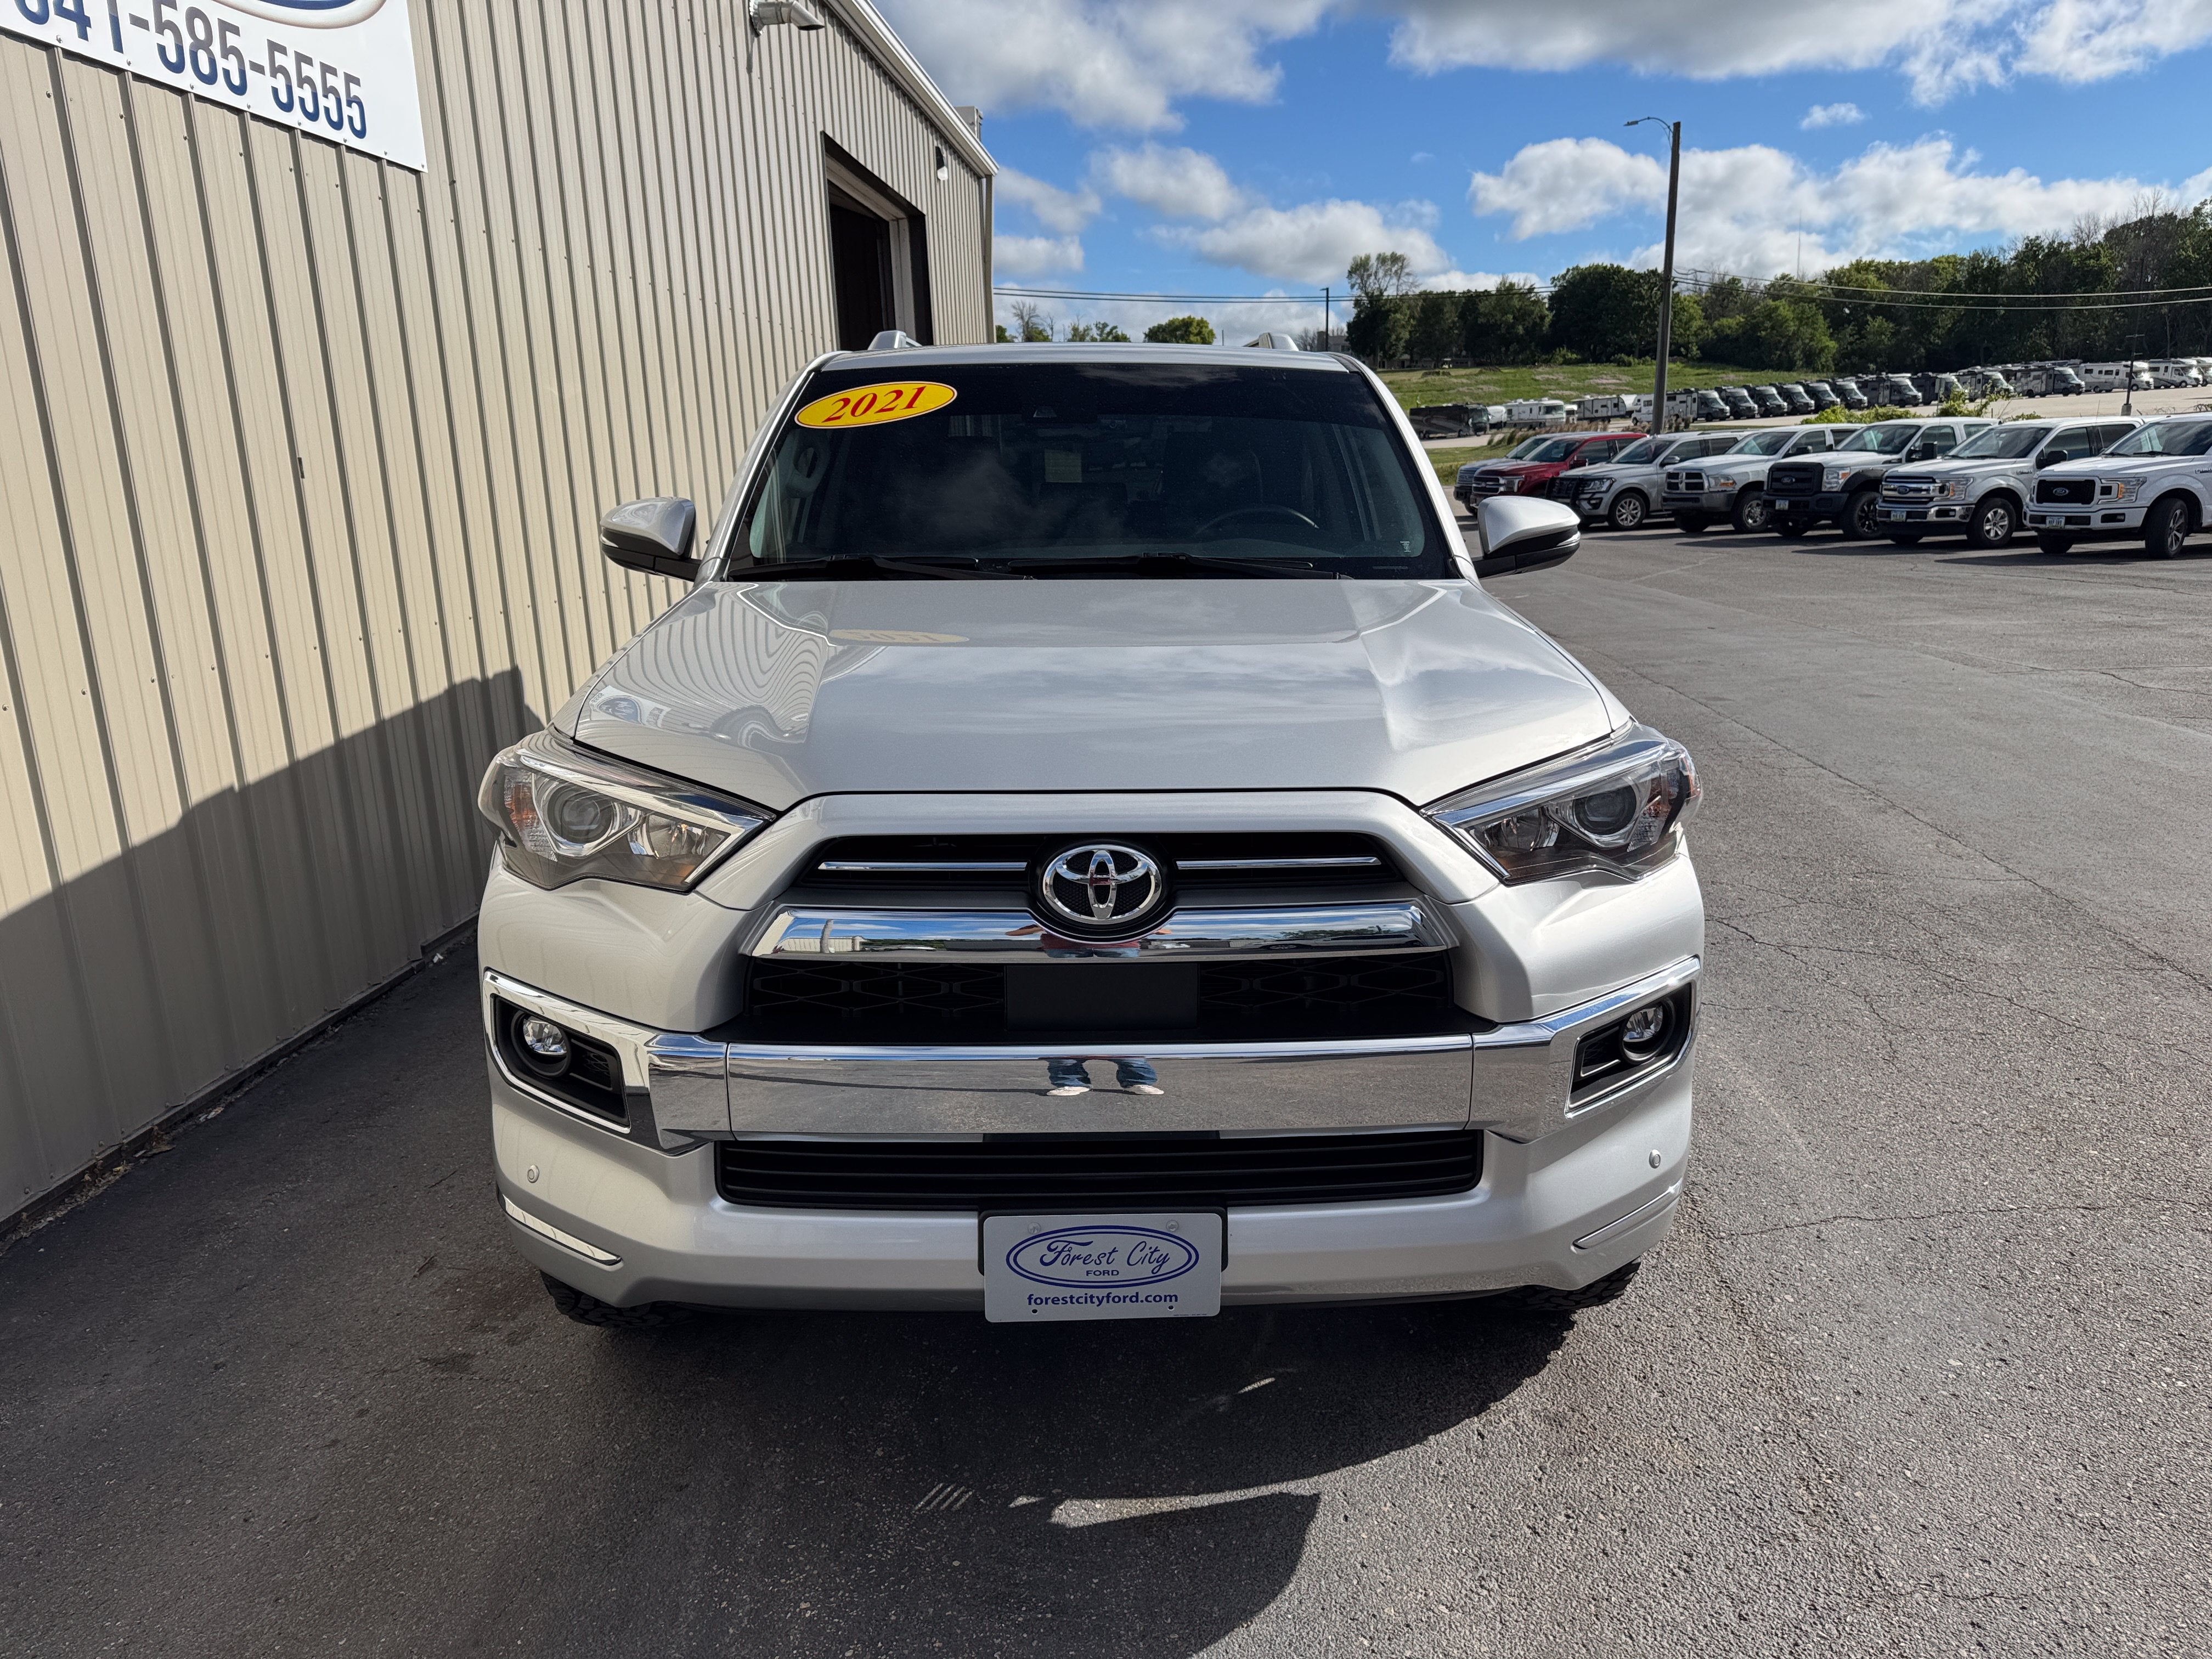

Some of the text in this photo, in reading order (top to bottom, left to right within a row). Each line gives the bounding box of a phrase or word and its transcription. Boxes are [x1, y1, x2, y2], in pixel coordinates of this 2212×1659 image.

[821, 386, 927, 423] 2021
[1039, 1240, 1170, 1274] Forest City
[1027, 1292, 1178, 1307] forestcityford.com
